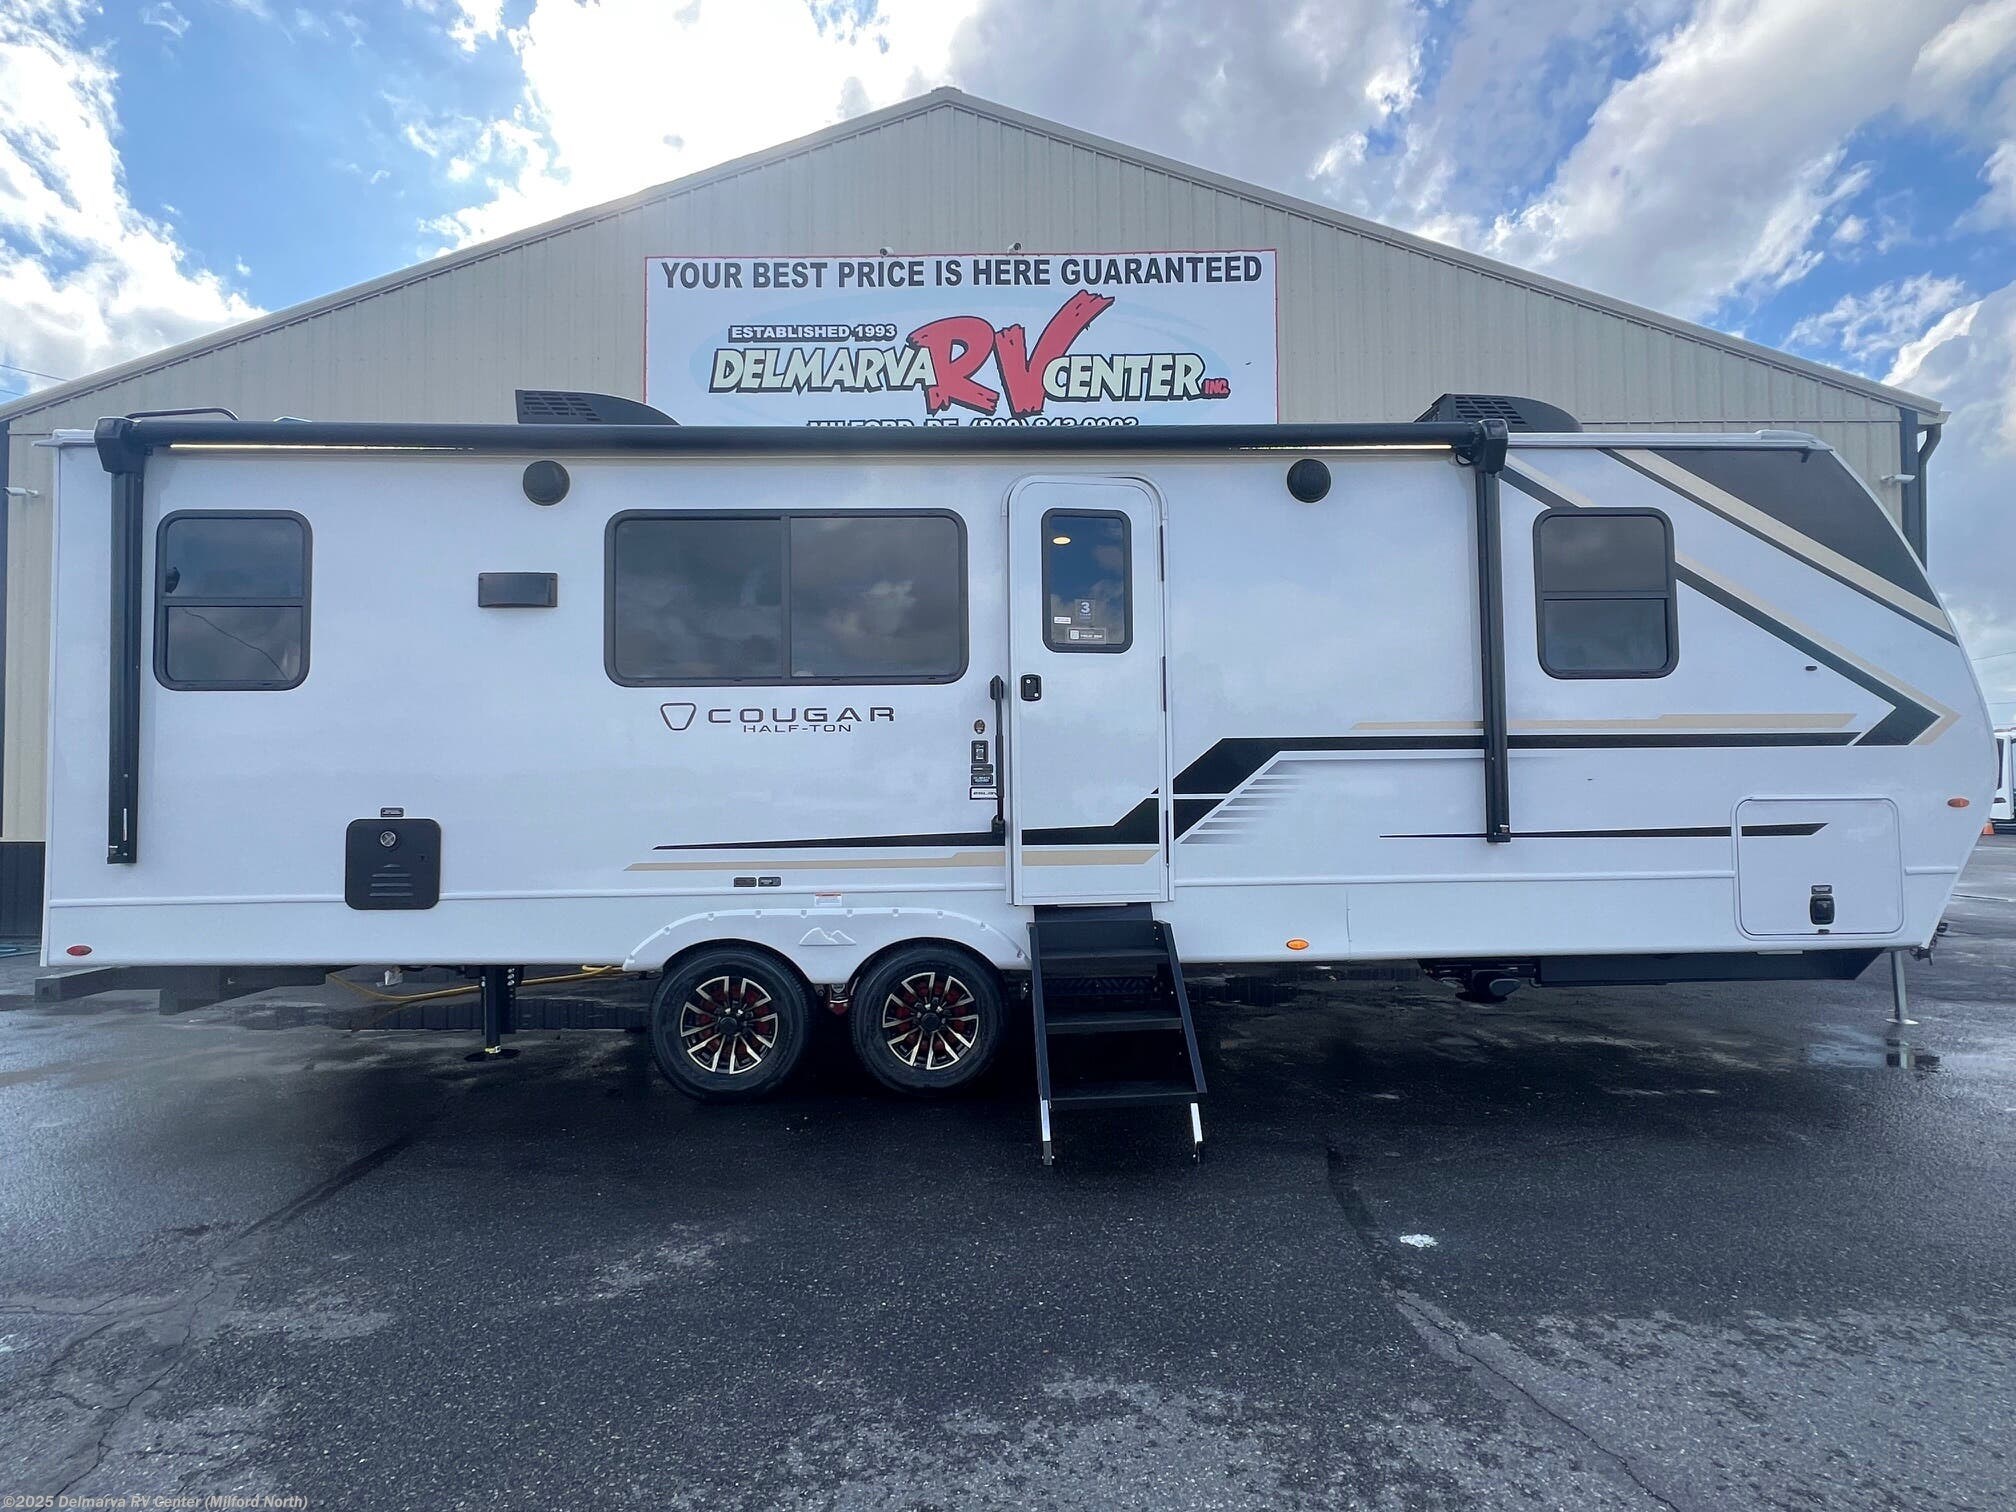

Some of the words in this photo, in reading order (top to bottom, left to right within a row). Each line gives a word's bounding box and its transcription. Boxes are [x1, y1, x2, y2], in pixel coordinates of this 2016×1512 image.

[661, 262, 743, 289] YOUR
[753, 262, 828, 288] BEST
[838, 261, 925, 288] PRICE
[935, 260, 963, 287] IS
[973, 259, 1050, 285] HERE
[1061, 256, 1262, 285] GUARANTEED
[730, 326, 850, 341] ESTABLISHED
[853, 325, 898, 339] 1993
[709, 346, 939, 394] DELMARVA
[906, 289, 1116, 418] RV
[1042, 353, 1205, 401] CENTER
[708, 706, 895, 724] COUGAR
[743, 723, 852, 733] HALF-TON
